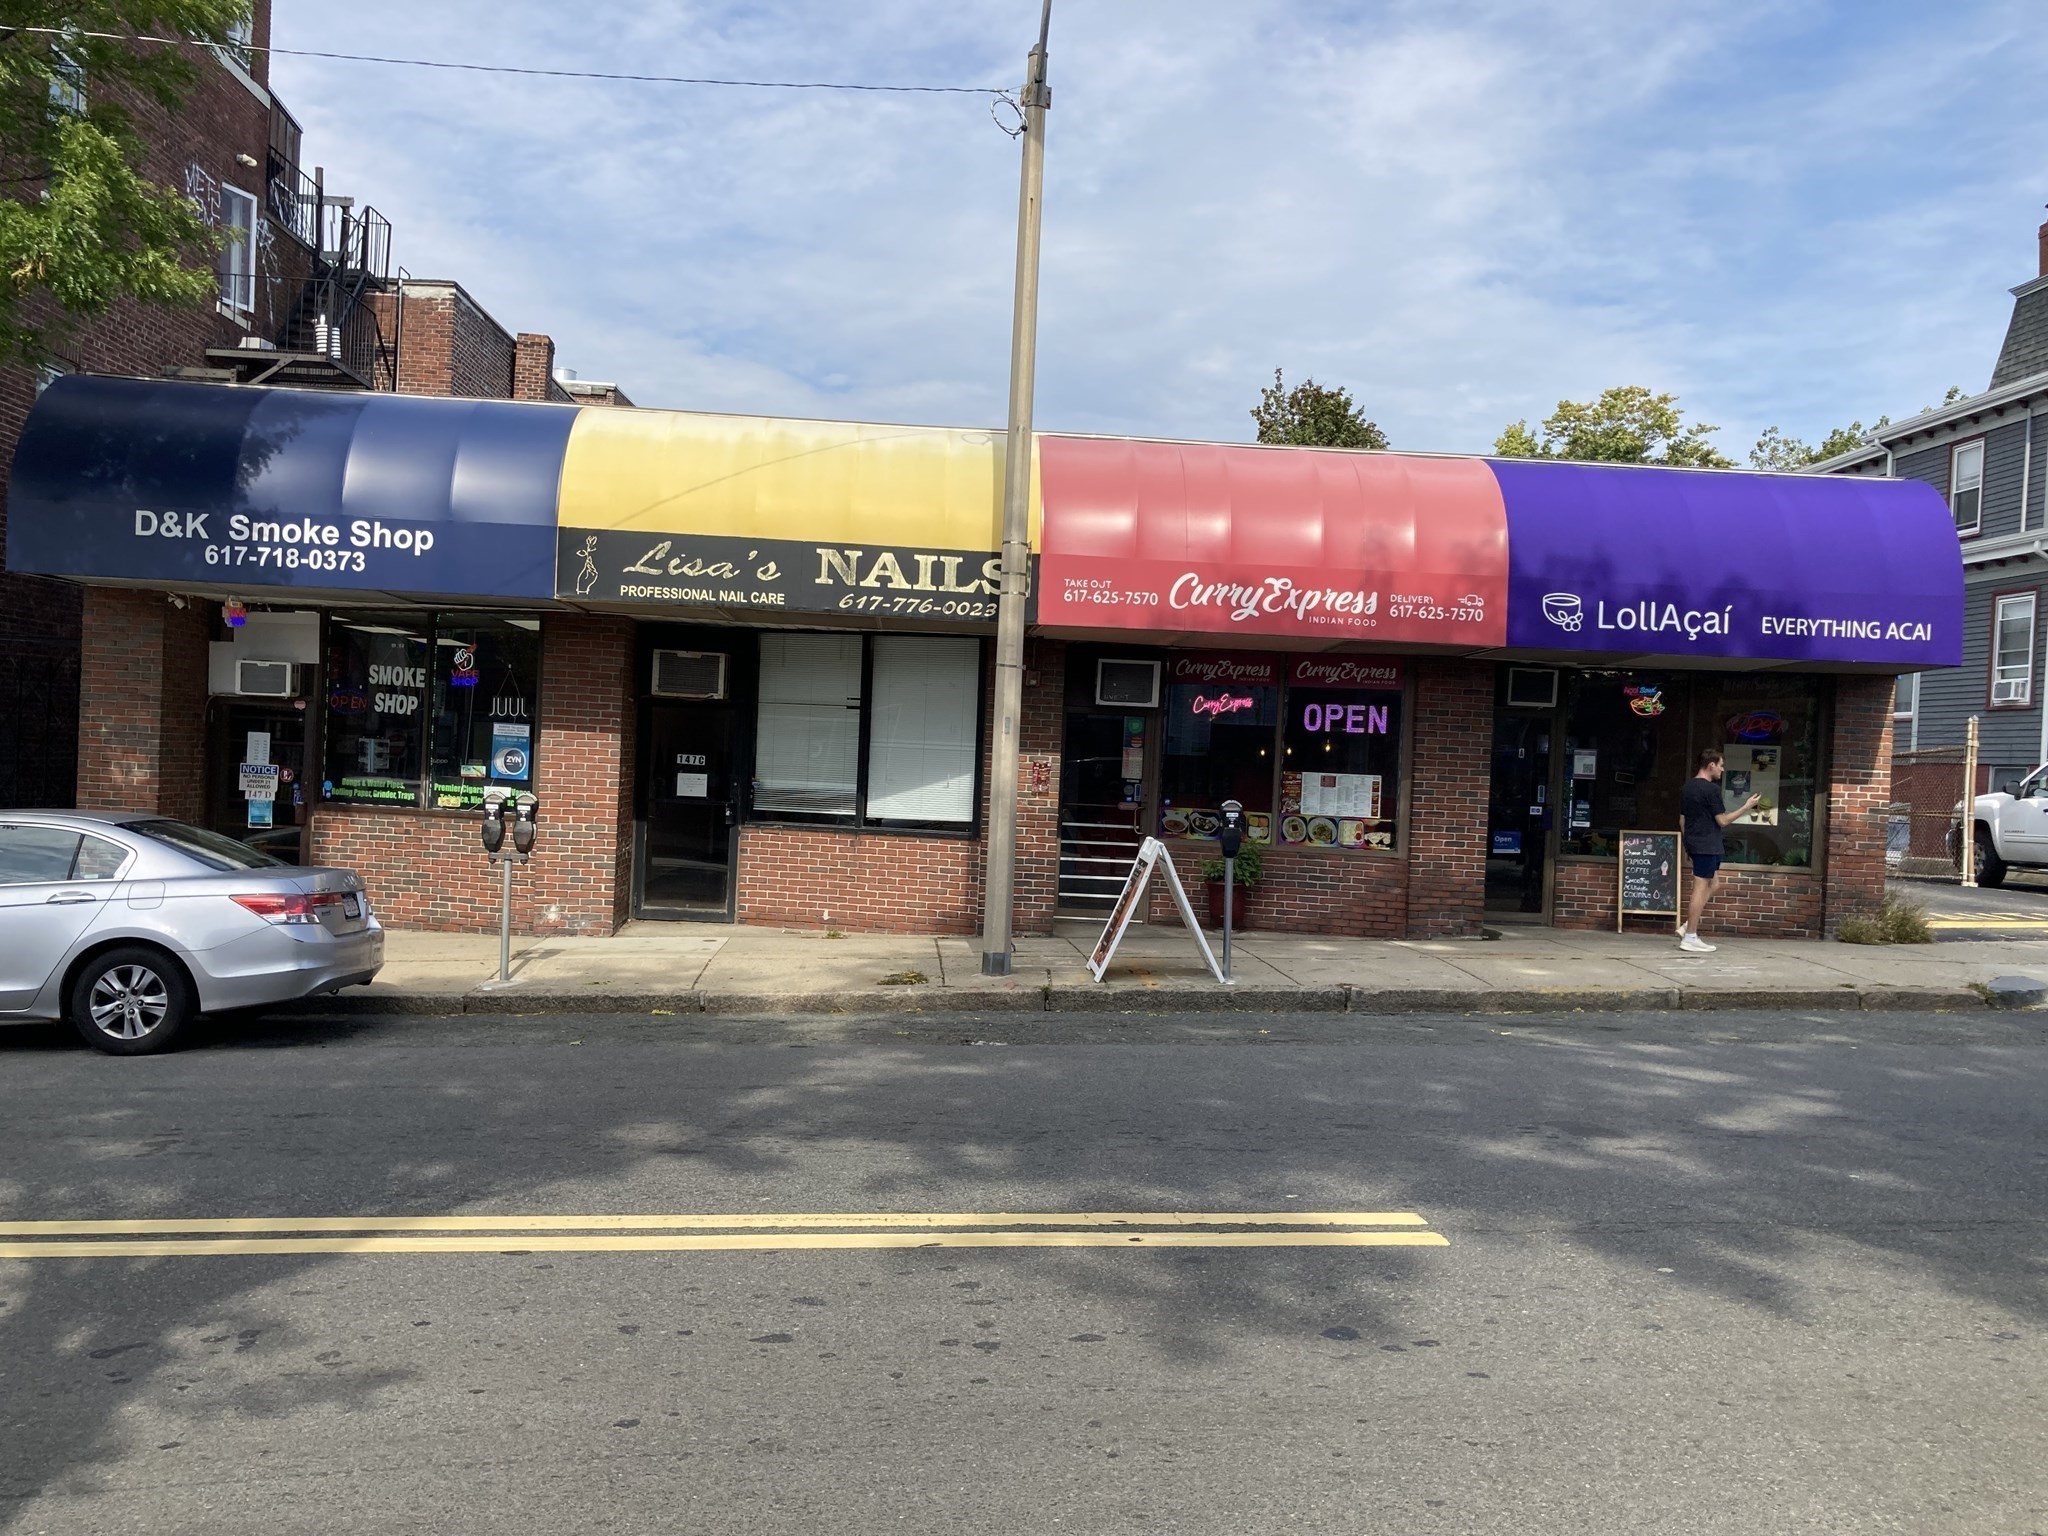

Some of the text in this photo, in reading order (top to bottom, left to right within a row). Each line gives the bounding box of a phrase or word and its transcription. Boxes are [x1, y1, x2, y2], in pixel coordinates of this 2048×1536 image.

[135, 510, 434, 555] D&K Smoke Shop
[205, 545, 365, 571] 617-718-0373
[623, 541, 782, 581] Lisa's
[1064, 578, 1112, 589] TAKE OUT
[620, 585, 785, 605] PROFESSIONAL NAIL CARE
[1063, 589, 1158, 606] 617-625-7570
[1390, 594, 1434, 604] DELIVERY
[838, 593, 998, 617] 617-776-0023
[1389, 605, 1484, 622] 617-625-7570
[1598, 601, 1932, 641] LollAçaí EVERYTHING ACAI
[1309, 616, 1377, 627] INDIAN FOOD
[368, 664, 426, 688] SMOKE
[451, 669, 479, 678] VAPE
[451, 678, 478, 686] SHOP
[330, 696, 367, 709] OPEN
[374, 692, 418, 715] SHOP
[489, 697, 527, 717] JUUL
[1304, 703, 1387, 734] OPEN
[506, 755, 522, 764] ZYN
[678, 755, 705, 765] 147C
[242, 765, 276, 775] NOTICE
[434, 783, 461, 792] Premier
[398, 791, 415, 800] Trays
[1625, 866, 1649, 875] COFFEE
